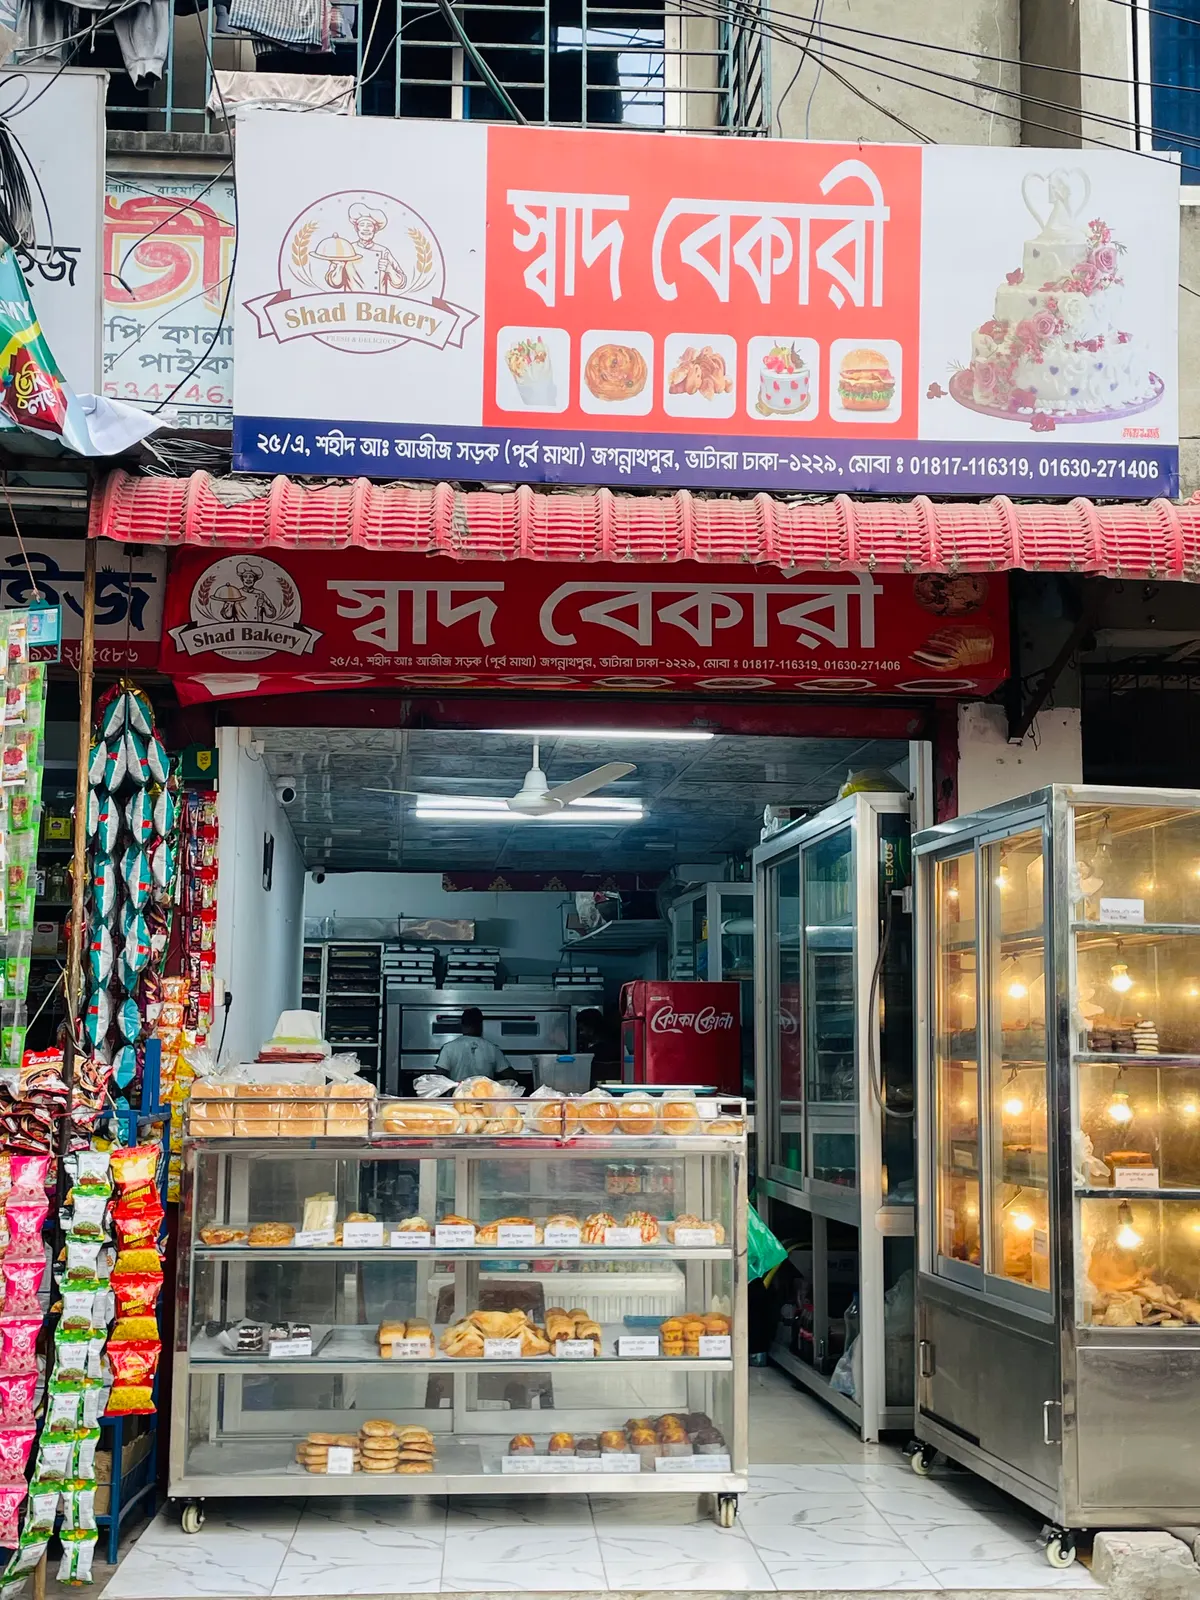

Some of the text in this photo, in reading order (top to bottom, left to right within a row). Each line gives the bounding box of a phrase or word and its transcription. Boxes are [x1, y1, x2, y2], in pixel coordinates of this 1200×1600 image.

[506, 159, 891, 310] স্বাদ বেকারী
[284, 301, 442, 337] Shad Bakery
[257, 432, 311, 457] ২৫/এ,
[315, 429, 356, 457] শহীদ
[360, 437, 389, 458] আঃ
[394, 433, 453, 460] আজীজ
[456, 441, 501, 465] সড়ক
[504, 439, 537, 469] (পূর্ব
[543, 441, 586, 467] মাথা)
[591, 446, 680, 474] জগন্নাথপুর,
[685, 444, 738, 471] ভাটারা
[742, 450, 844, 476] ঢাকা-১২২৯,
[848, 454, 892, 475] মোবা
[909, 456, 1034, 479] 01817-116319,
[1038, 459, 1160, 479] 01630-271406
[327, 567, 884, 653] স্বাদ বেকারী
[192, 627, 301, 649] Shad Bakery
[329, 656, 364, 668] ২৫/এ,
[366, 653, 391, 667] শহীদ
[394, 656, 412, 668] আঃ
[416, 654, 451, 668] আজীজ
[454, 656, 482, 669] সড়ক
[485, 656, 507, 670] (পূর্ব
[510, 656, 537, 669] মাথা)
[540, 656, 597, 671] জগন্নাথপুর,
[599, 655, 633, 668] ভাটারা
[636, 657, 700, 670] ঢাকা-১২২৯,
[703, 657, 730, 670] মোবা
[823, 659, 901, 671] 01630-271406
[885, 843, 894, 883] LEXUS
